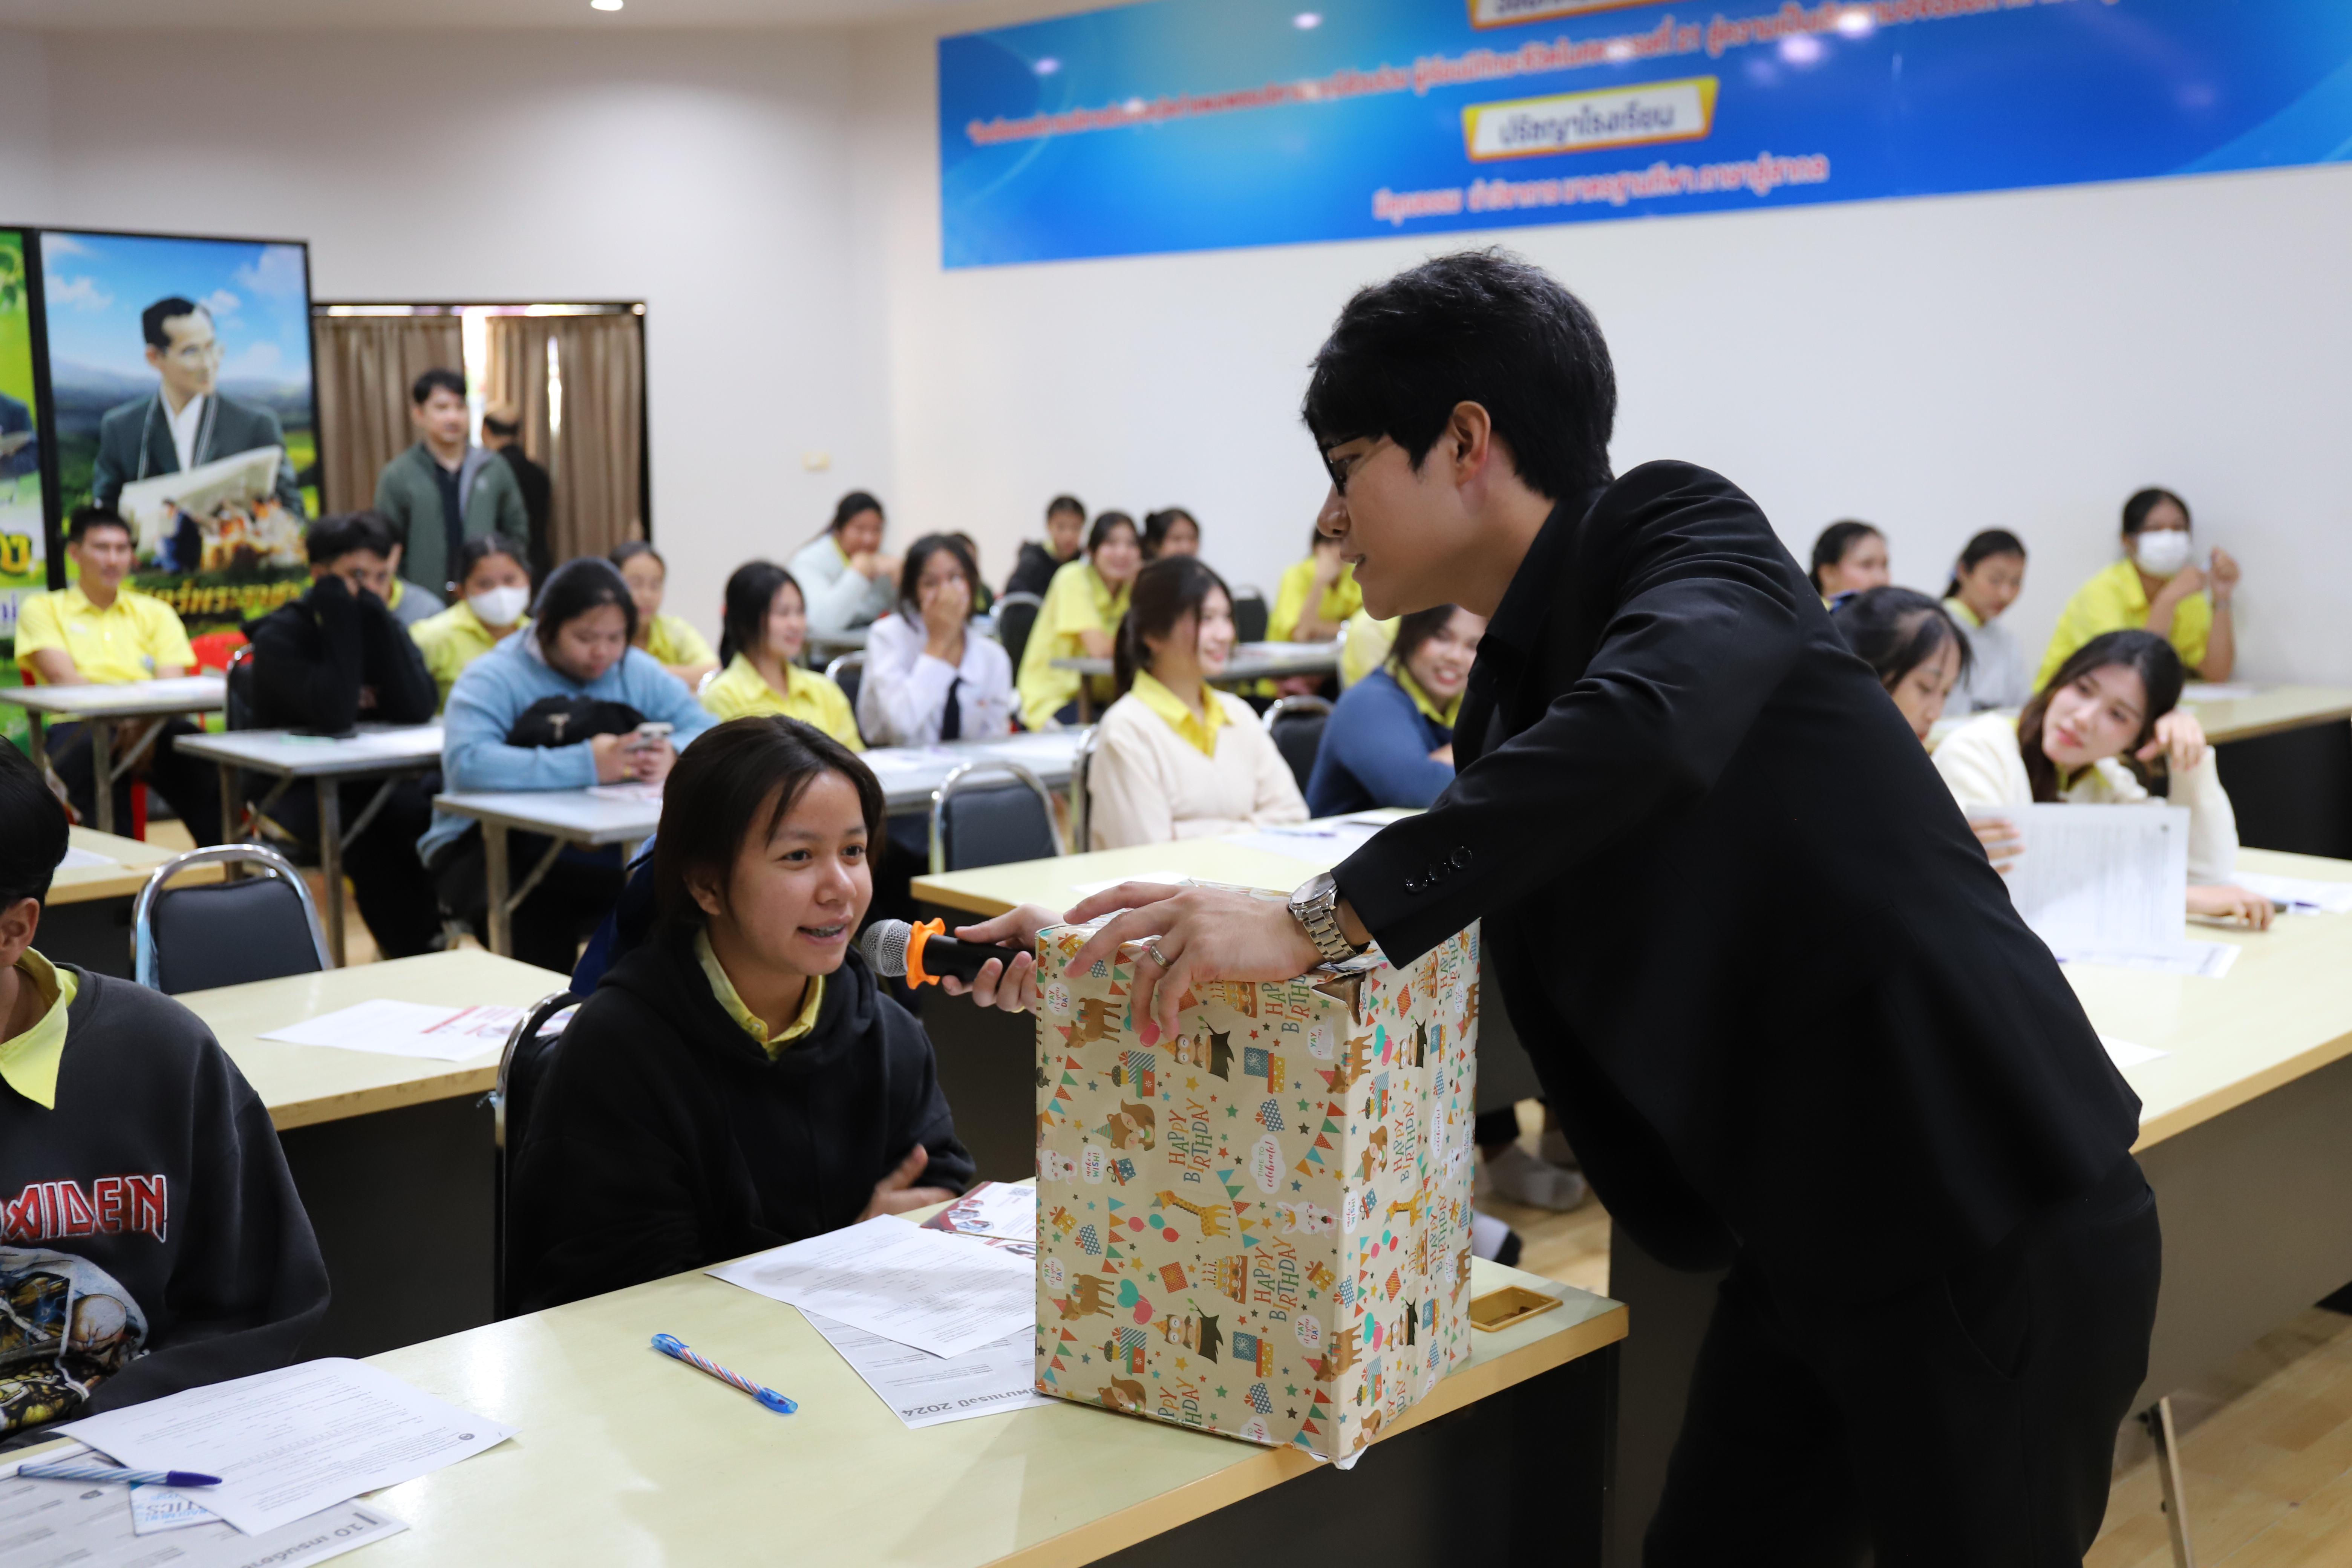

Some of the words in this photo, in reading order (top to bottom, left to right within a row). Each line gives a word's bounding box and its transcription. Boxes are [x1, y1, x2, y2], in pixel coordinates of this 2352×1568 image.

[1446, 938, 1458, 1001] BIRTHD
[1281, 975, 1310, 1033] BIRTHD
[1168, 1109, 1189, 1165] HAPPY
[1184, 1097, 1212, 1184] BIRTHDAY
[1259, 1147, 1264, 1155] TO
[1265, 1141, 1275, 1187] celebrate!
[1393, 1118, 1404, 1173] HAPPY
[1401, 1100, 1415, 1184] BIRTHDAY
[0, 1174, 167, 1243] AIDEN
[1436, 1195, 1447, 1274] BIRTHDAY
[1254, 1246, 1276, 1304] HAPPY
[1269, 1236, 1299, 1322] BIRTHDAY
[901, 1402, 952, 1417] 2024
[334, 1523, 364, 1537] 10
